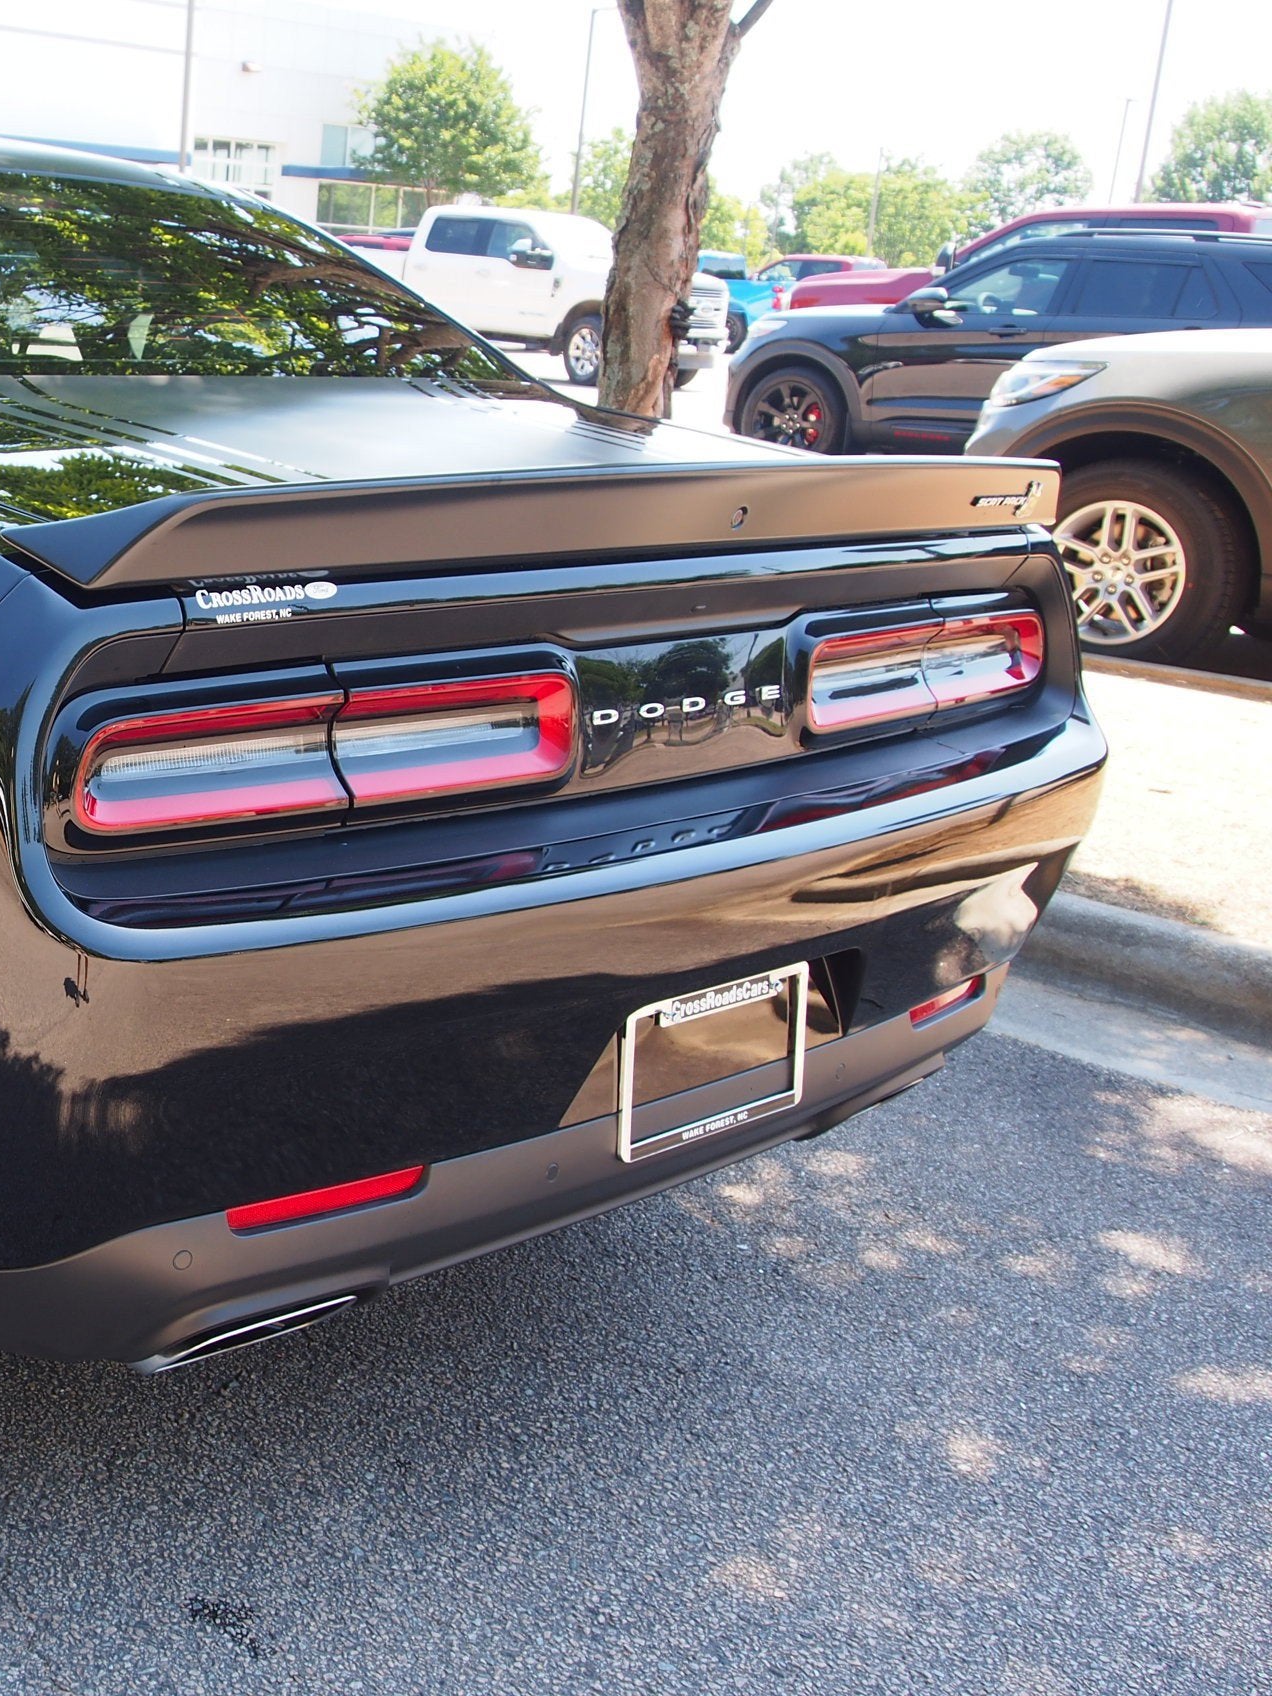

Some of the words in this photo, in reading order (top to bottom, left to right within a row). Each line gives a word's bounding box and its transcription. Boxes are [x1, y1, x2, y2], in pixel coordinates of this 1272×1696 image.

[216, 613, 242, 624] WAKE
[243, 609, 279, 622] FOREST,
[279, 607, 292, 618] NC
[592, 684, 781, 726] DODGE
[682, 1126, 705, 1140] WAKE
[705, 1115, 737, 1132] FOREST,
[737, 1111, 749, 1122] NC
